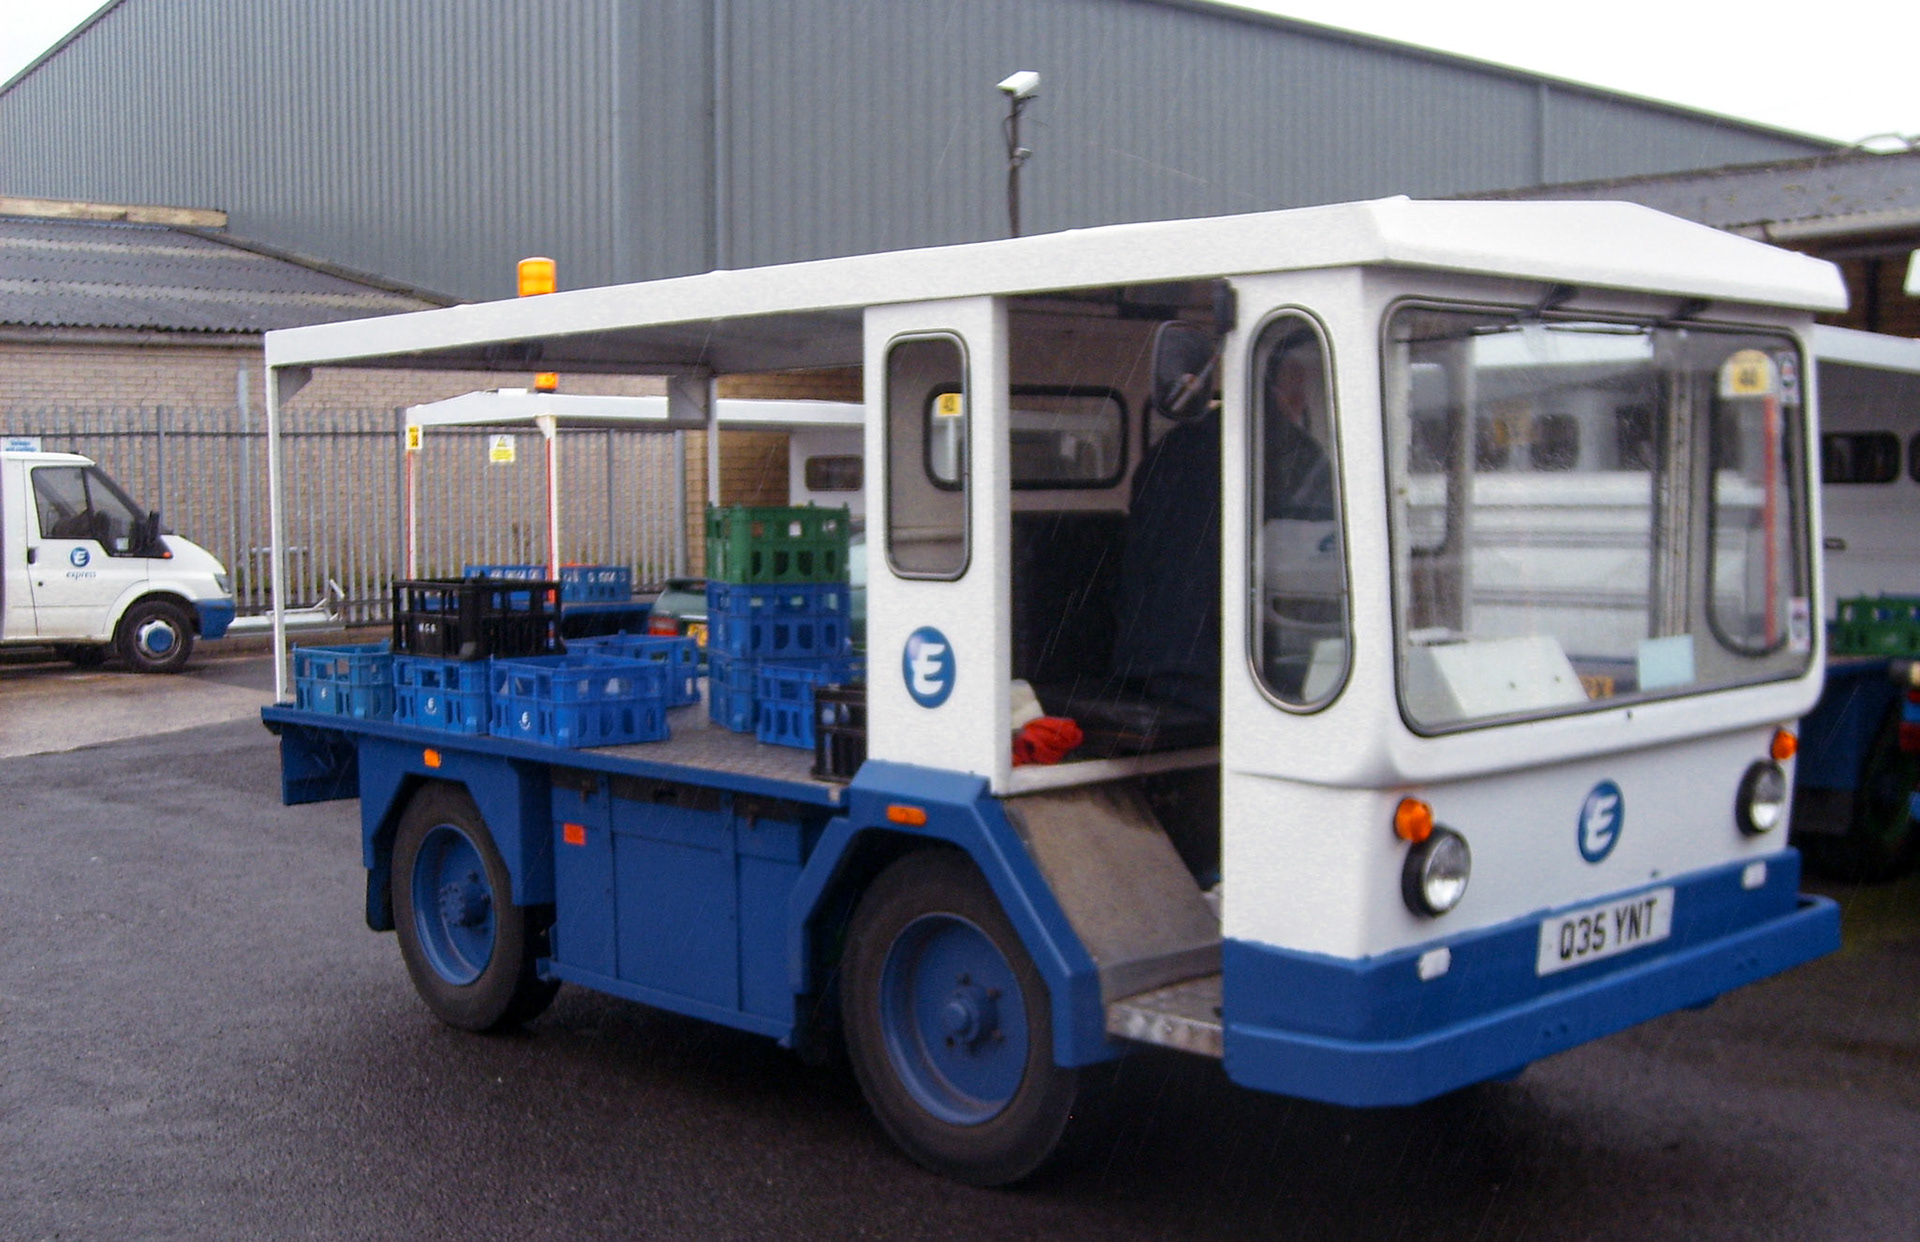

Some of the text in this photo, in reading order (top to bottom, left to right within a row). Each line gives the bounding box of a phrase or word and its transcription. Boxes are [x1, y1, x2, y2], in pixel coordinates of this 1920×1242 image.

[66, 571, 97, 580] express
[907, 636, 947, 697] E
[1584, 791, 1620, 855] E
[1560, 898, 1657, 960] Q35 YNT
